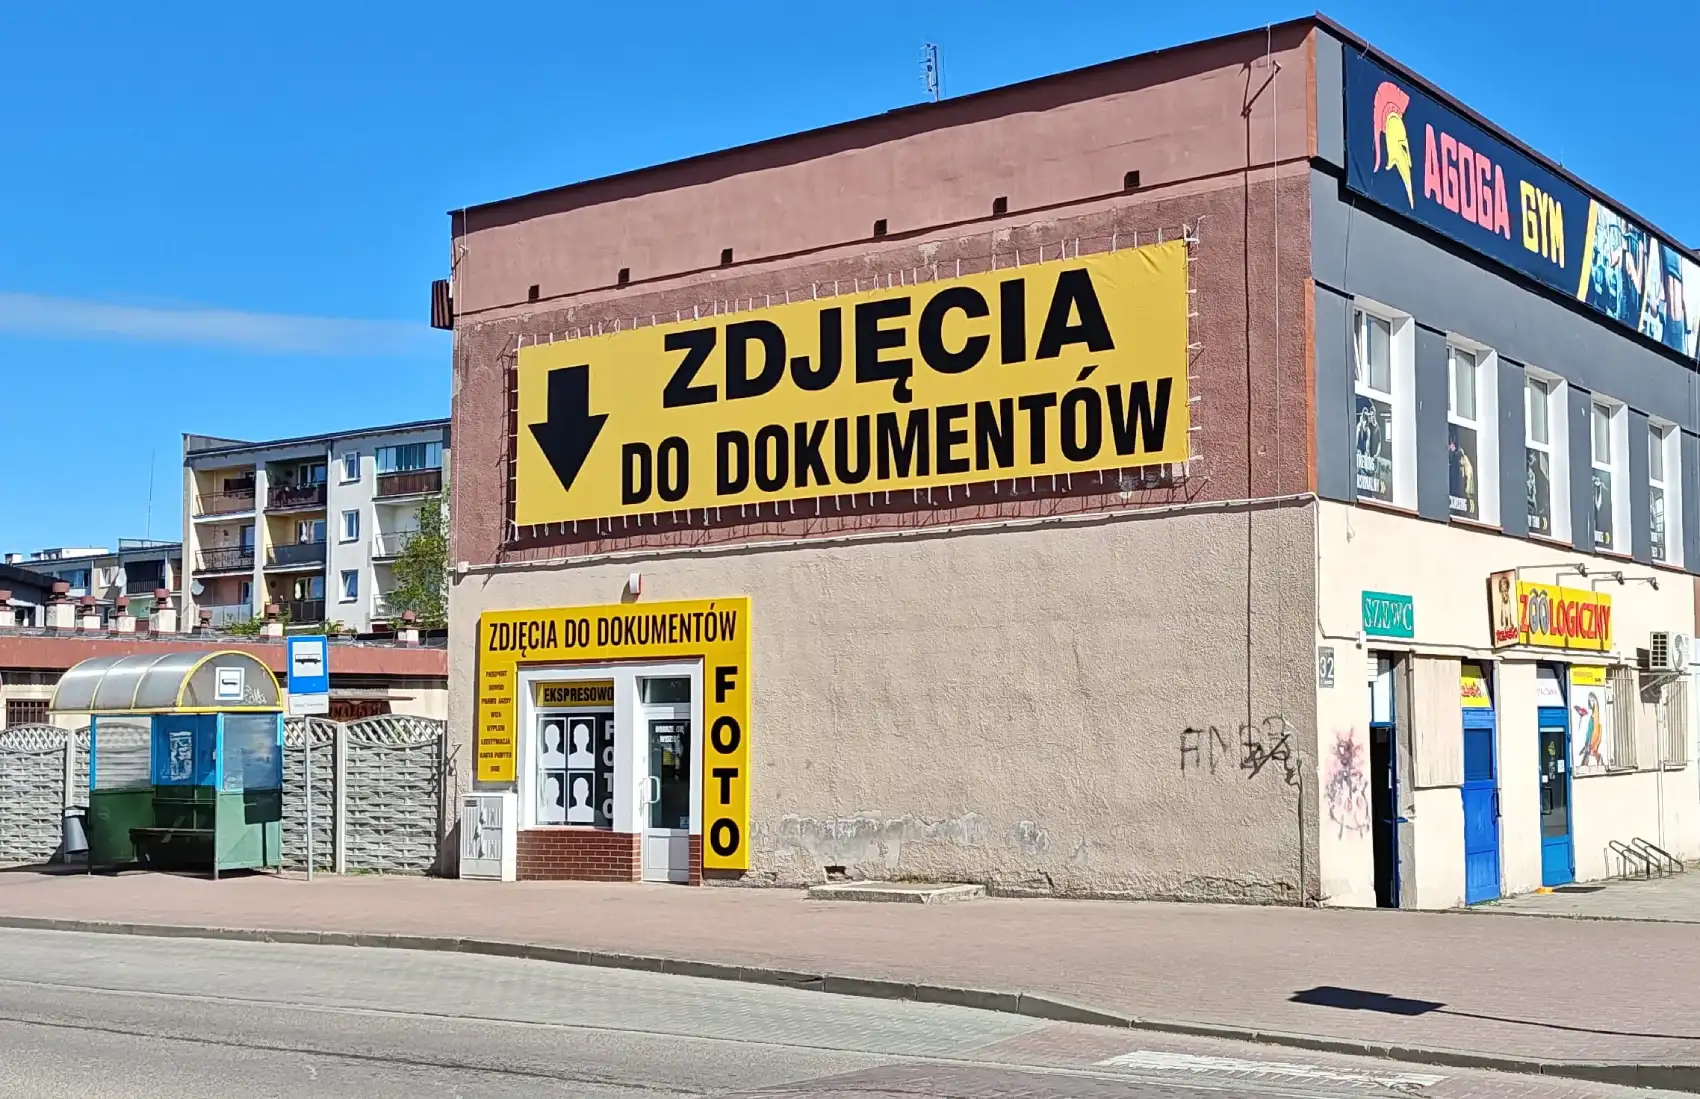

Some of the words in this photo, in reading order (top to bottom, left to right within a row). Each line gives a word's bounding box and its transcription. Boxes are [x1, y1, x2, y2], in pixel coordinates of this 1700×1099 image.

[1424, 123, 1511, 240] AGOGA
[1519, 180, 1565, 269] GYM
[663, 268, 1115, 408] ZDJĘCIA
[621, 435, 690, 506] DO
[717, 365, 1173, 496] DOKUMENTÓW
[488, 619, 558, 658] ZDJĘCIA
[565, 618, 590, 649] DO
[597, 602, 737, 647] DOKUMENTÓW
[1364, 597, 1413, 631] SZEWC
[1519, 589, 1611, 642] ZOOLOGICZNY
[543, 686, 614, 703] EKSPRESOWO
[1319, 656, 1334, 679] 32
[710, 665, 741, 857] FOTO
